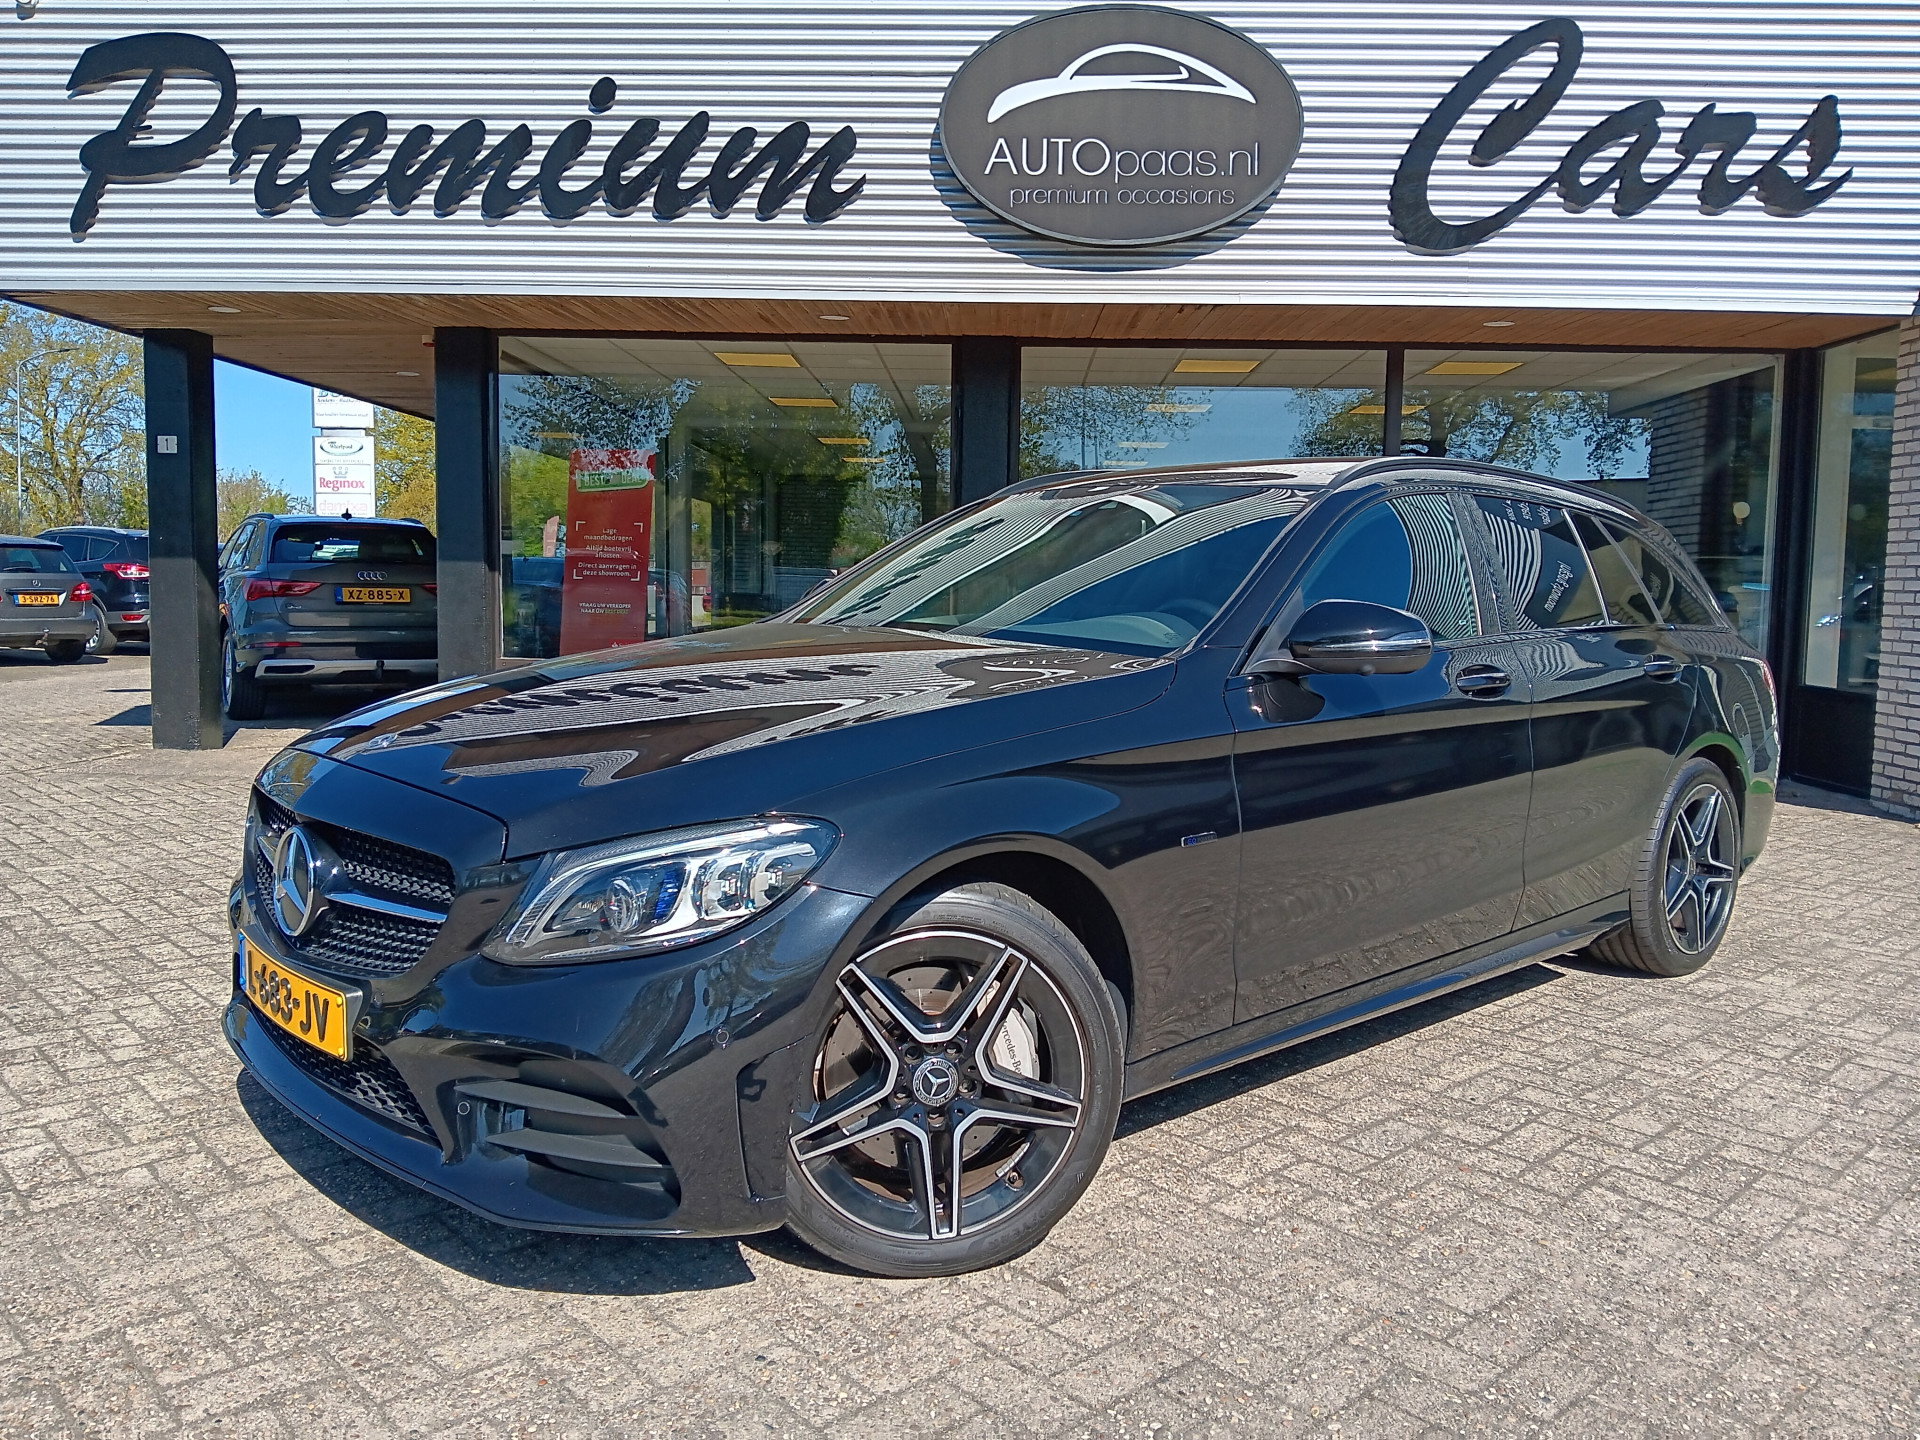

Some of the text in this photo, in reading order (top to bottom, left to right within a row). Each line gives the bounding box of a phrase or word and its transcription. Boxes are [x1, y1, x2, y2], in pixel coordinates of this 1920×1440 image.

[67, 18, 1853, 255] Premium Cars
[983, 137, 1259, 184] AUTOpaas.nl
[1010, 185, 1235, 208] premium occasions
[319, 477, 365, 492] Reginox
[585, 544, 603, 552] Altijd
[21, 595, 55, 603] 3-SRZ-76
[347, 589, 405, 600] XZ-885-X
[247, 950, 330, 1043] L-683-JV
[1001, 1021, 1023, 1075] ercedes-Be
